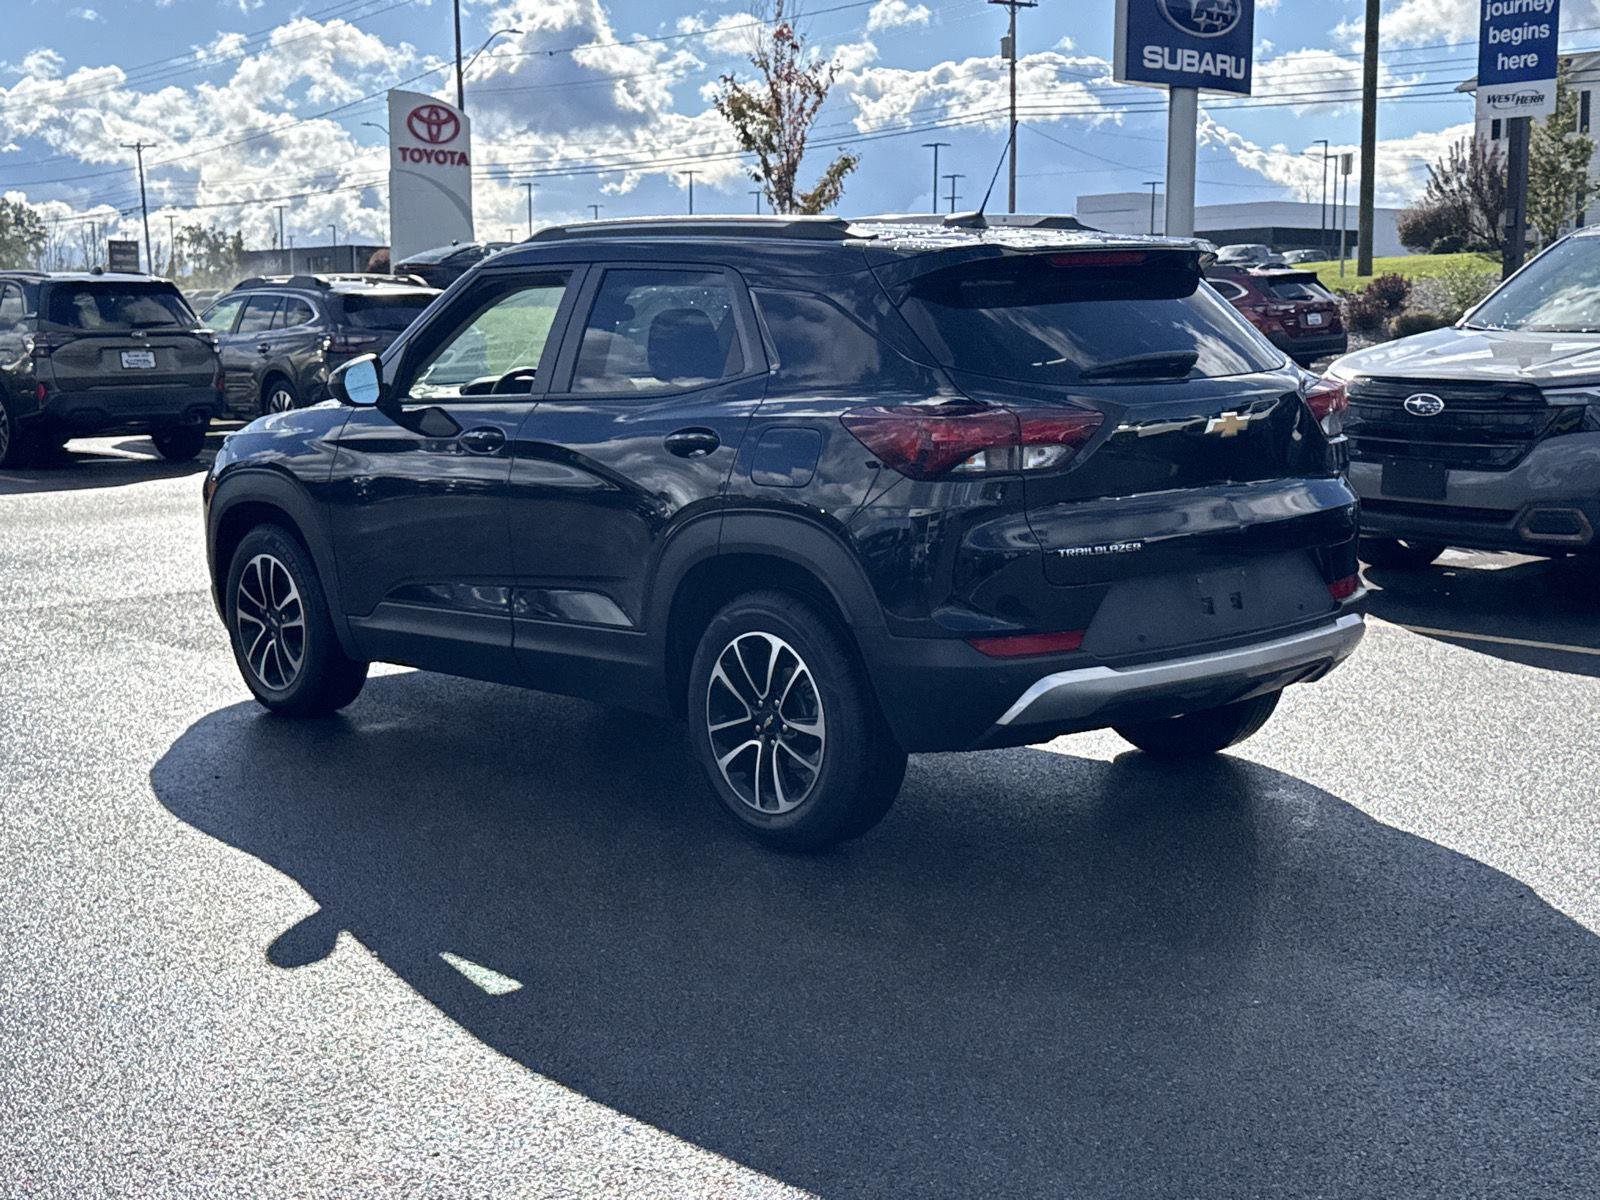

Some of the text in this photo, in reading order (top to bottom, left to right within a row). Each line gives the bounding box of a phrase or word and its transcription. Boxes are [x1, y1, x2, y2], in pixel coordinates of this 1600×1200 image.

[1485, 0, 1554, 21] journey
[1488, 22, 1550, 45] begins
[1142, 45, 1246, 79] SUBARU
[1497, 53, 1539, 71] here
[398, 147, 470, 166] TOYOTA
[1057, 543, 1141, 557] TRAILBLAZER
